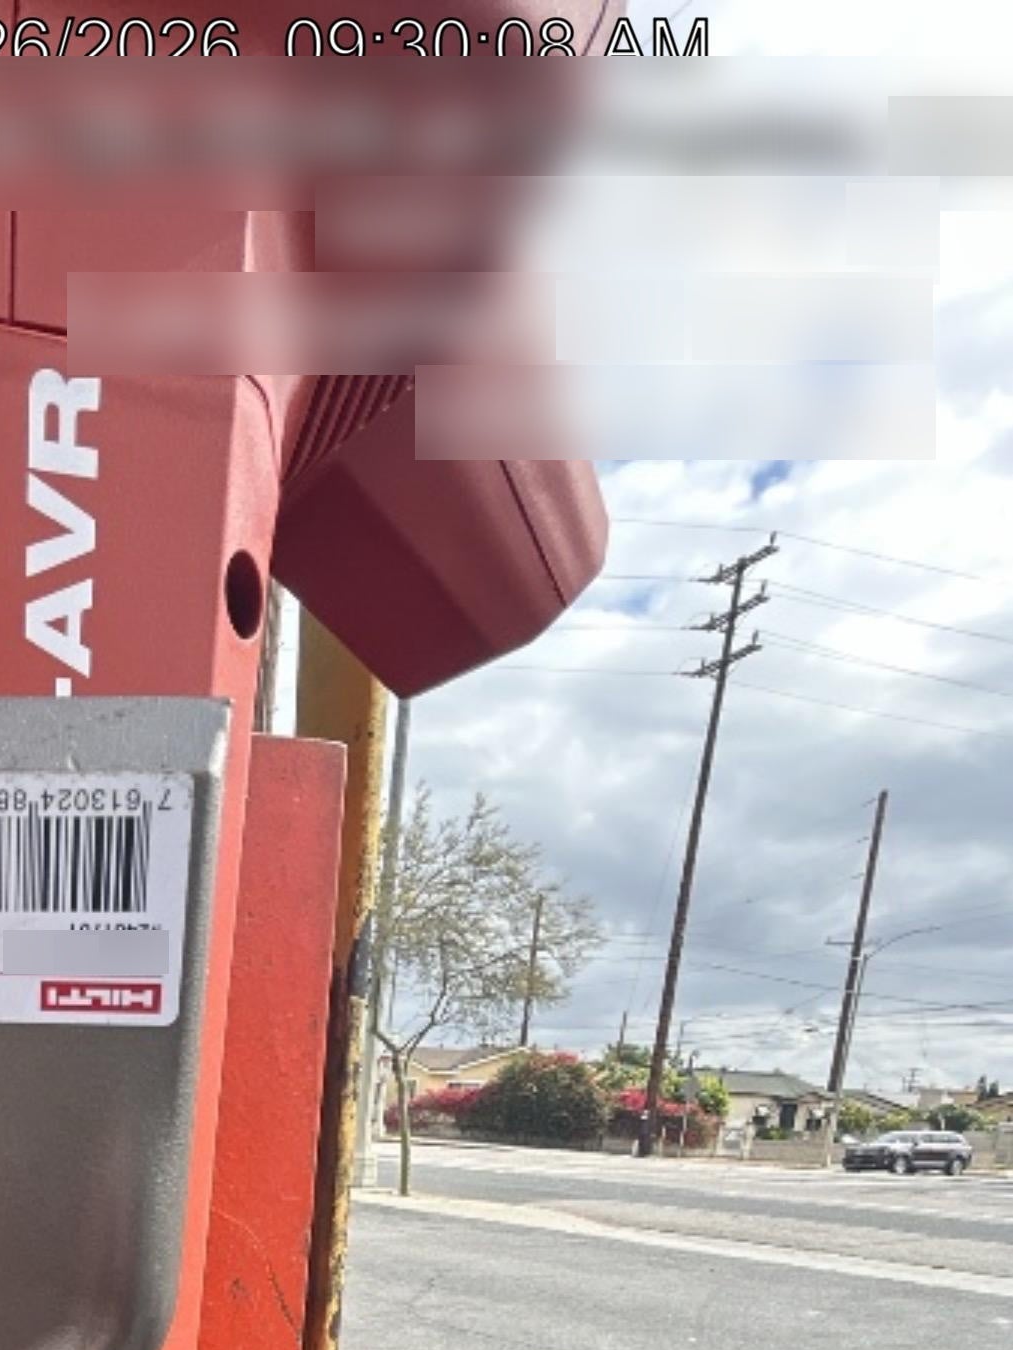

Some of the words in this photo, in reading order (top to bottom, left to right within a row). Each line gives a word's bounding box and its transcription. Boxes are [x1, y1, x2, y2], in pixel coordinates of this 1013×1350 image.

[40, 788, 142, 811] 613024
[157, 788, 172, 811] 7
[46, 986, 154, 1009] HILTI
